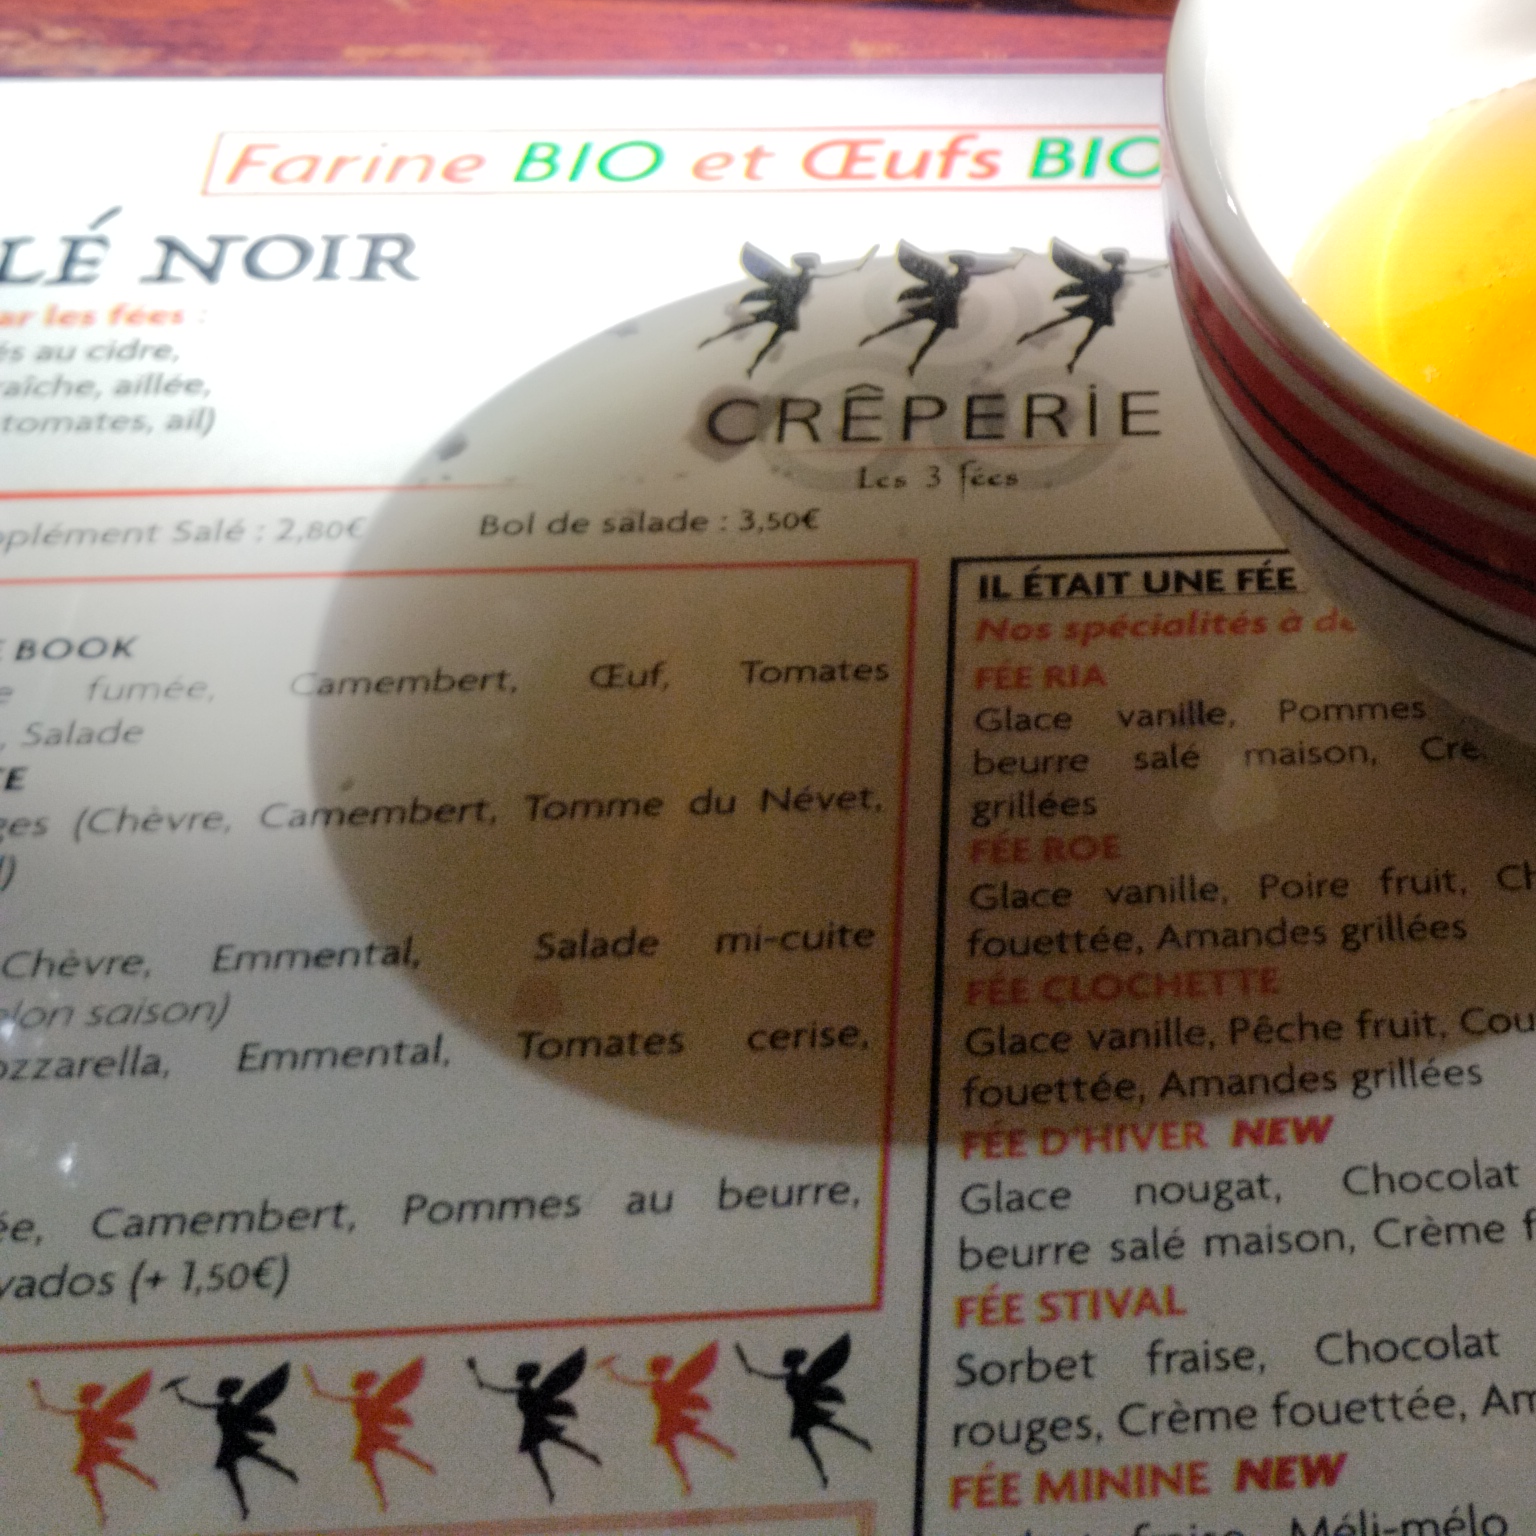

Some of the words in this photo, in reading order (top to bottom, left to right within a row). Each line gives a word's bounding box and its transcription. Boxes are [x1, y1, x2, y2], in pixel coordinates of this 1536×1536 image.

[224, 141, 487, 186] Farine
[512, 140, 667, 183] BIO
[690, 142, 775, 183] et
[801, 133, 1002, 182] Œufs
[137, 233, 420, 287] NOIR
[35, 345, 77, 363] au
[85, 337, 181, 364] cidre,
[113, 370, 212, 399] aillée,
[2, 412, 154, 437] tomates,
[164, 407, 217, 439] ail)
[859, 468, 908, 490] Les
[925, 466, 940, 488] 3
[547, 512, 590, 536] de
[601, 509, 709, 535] salade
[738, 507, 821, 535] 3,50€
[977, 572, 1013, 601] IL
[15, 635, 139, 661] BOOK
[87, 673, 215, 703] fumée,
[289, 663, 519, 699] Camembert,
[589, 661, 669, 692] Œuf,
[739, 659, 890, 687] Tomates
[1043, 665, 1107, 690] RIA
[20, 719, 144, 748] Salade
[73, 805, 232, 843] (Chèvre,
[259, 796, 498, 831] Camembert,
[525, 791, 665, 823] Tomme
[688, 787, 736, 817] du
[1041, 834, 1121, 862] ROE
[211, 936, 421, 974] Emmental,
[533, 926, 660, 962] Salade
[714, 921, 877, 955] mi-cuite
[1156, 917, 1327, 951] Amandes
[1043, 966, 1280, 1004] CLOCHETTE
[84, 991, 232, 1032] saison)
[236, 1033, 451, 1074] Emmental,
[517, 1029, 685, 1061] Tomates
[747, 1021, 870, 1055] cerise,
[1160, 1062, 1338, 1101] Amandes
[1040, 1117, 1209, 1156] D'HIVER
[960, 1181, 1072, 1215] Glace
[1134, 1172, 1282, 1212] nougat,
[1342, 1158, 1521, 1196] Chocolat
[91, 1199, 357, 1242] Camembert,
[402, 1186, 582, 1226] Pommes
[626, 1189, 675, 1215] au
[717, 1176, 861, 1211] beurre,
[958, 1235, 1091, 1272] beurre
[1204, 1224, 1357, 1257] maison,
[1373, 1215, 1506, 1249] Crème
[182, 1252, 291, 1298] 1,50€)
[1037, 1284, 1188, 1325] STIVAL
[954, 1346, 1096, 1388] Sorbet
[1315, 1323, 1501, 1366] Chocolat
[952, 1412, 1104, 1457] rouges,
[1117, 1399, 1258, 1438] Crème
[1272, 1385, 1466, 1428] fouettée,
[1034, 1459, 1213, 1505] MININE
[1234, 1452, 1348, 1494] NEW
